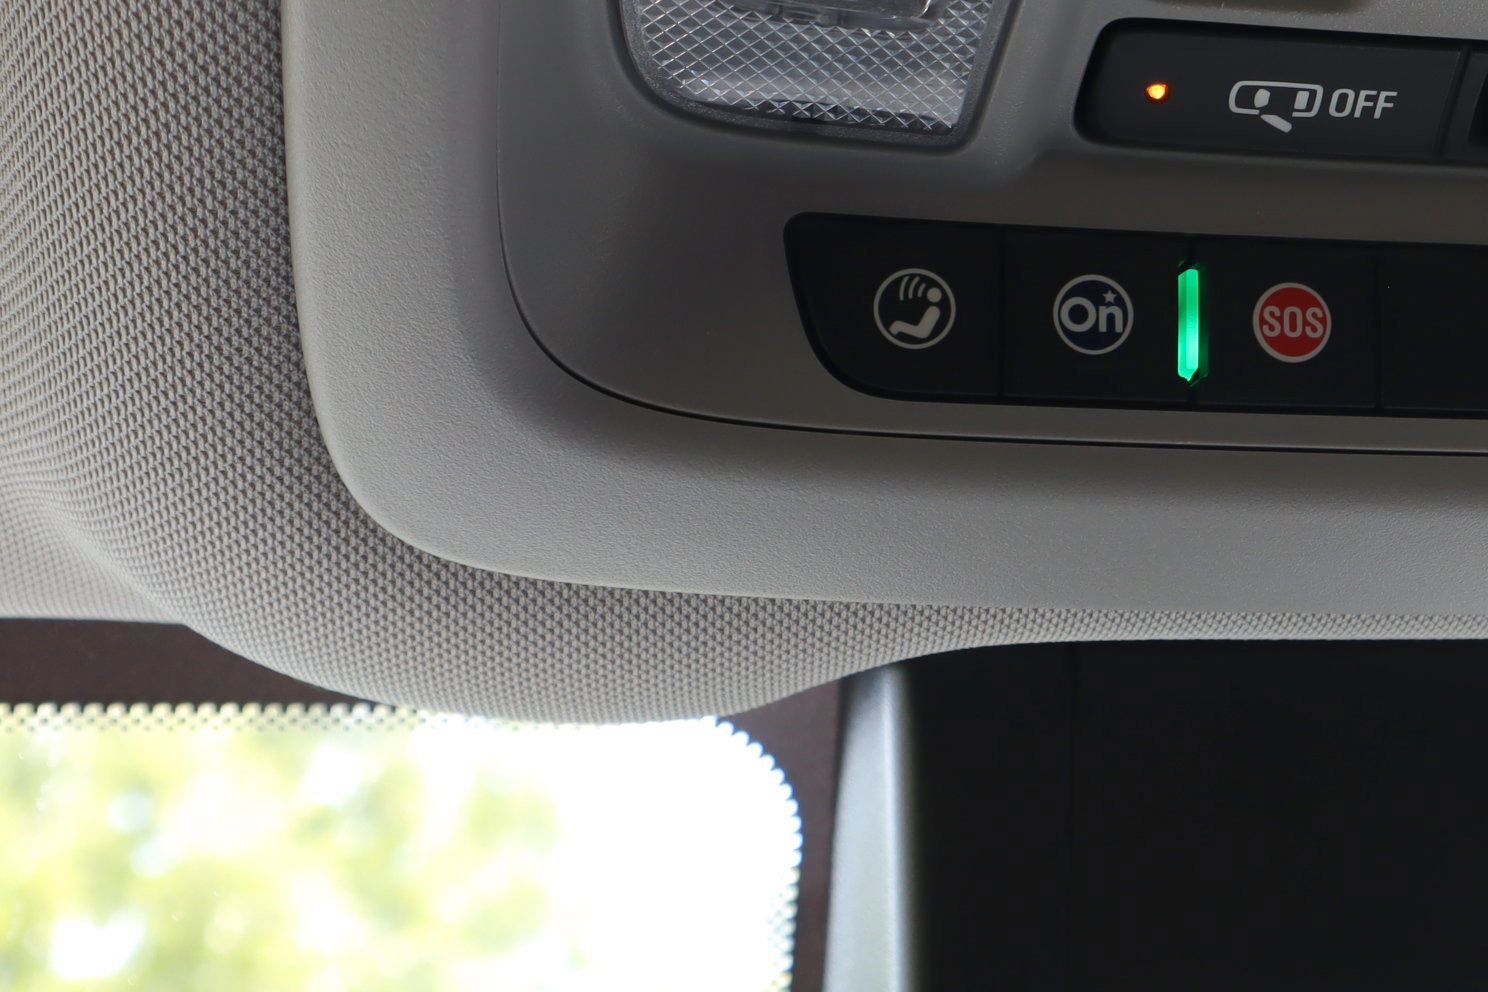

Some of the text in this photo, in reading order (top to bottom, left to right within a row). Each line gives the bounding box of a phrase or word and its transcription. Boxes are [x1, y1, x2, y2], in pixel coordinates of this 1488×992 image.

[1329, 87, 1398, 119] OFF
[1060, 294, 1122, 333] On
[1262, 305, 1324, 339] SOS
